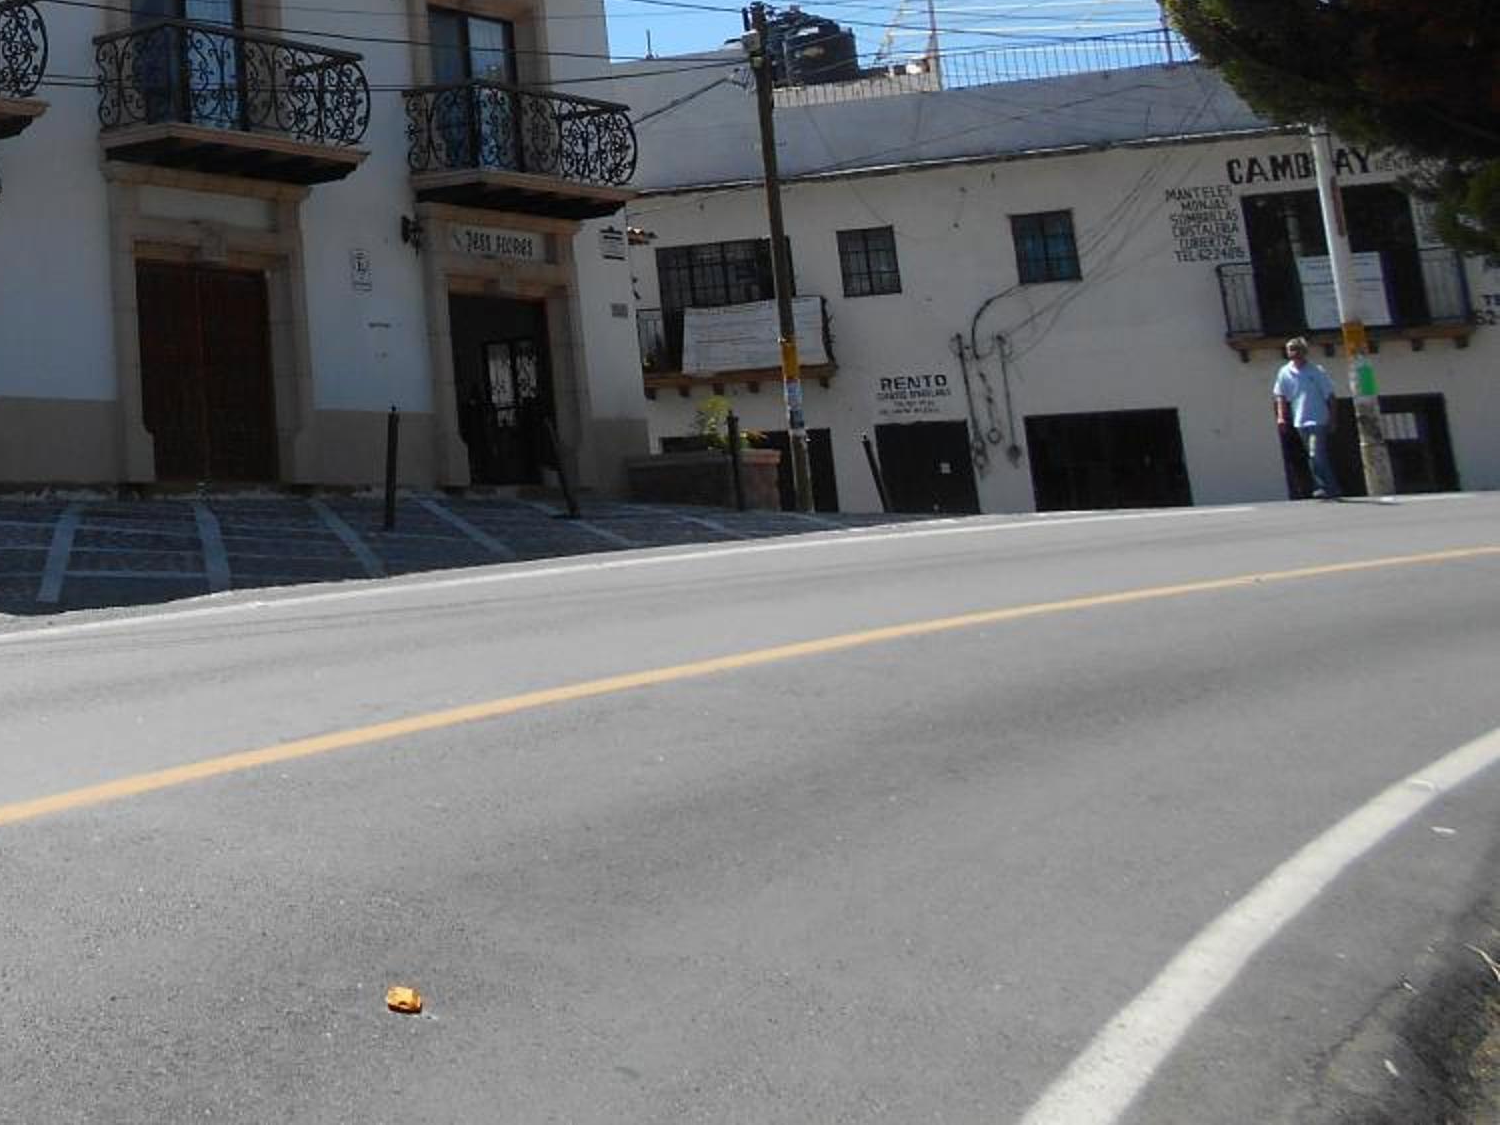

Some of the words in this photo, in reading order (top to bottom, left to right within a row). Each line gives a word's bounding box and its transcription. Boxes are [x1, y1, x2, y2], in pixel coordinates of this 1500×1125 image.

[1226, 149, 1370, 185] CAMBAY
[1164, 184, 1233, 202] MANTELES
[880, 374, 947, 391] RENTO
